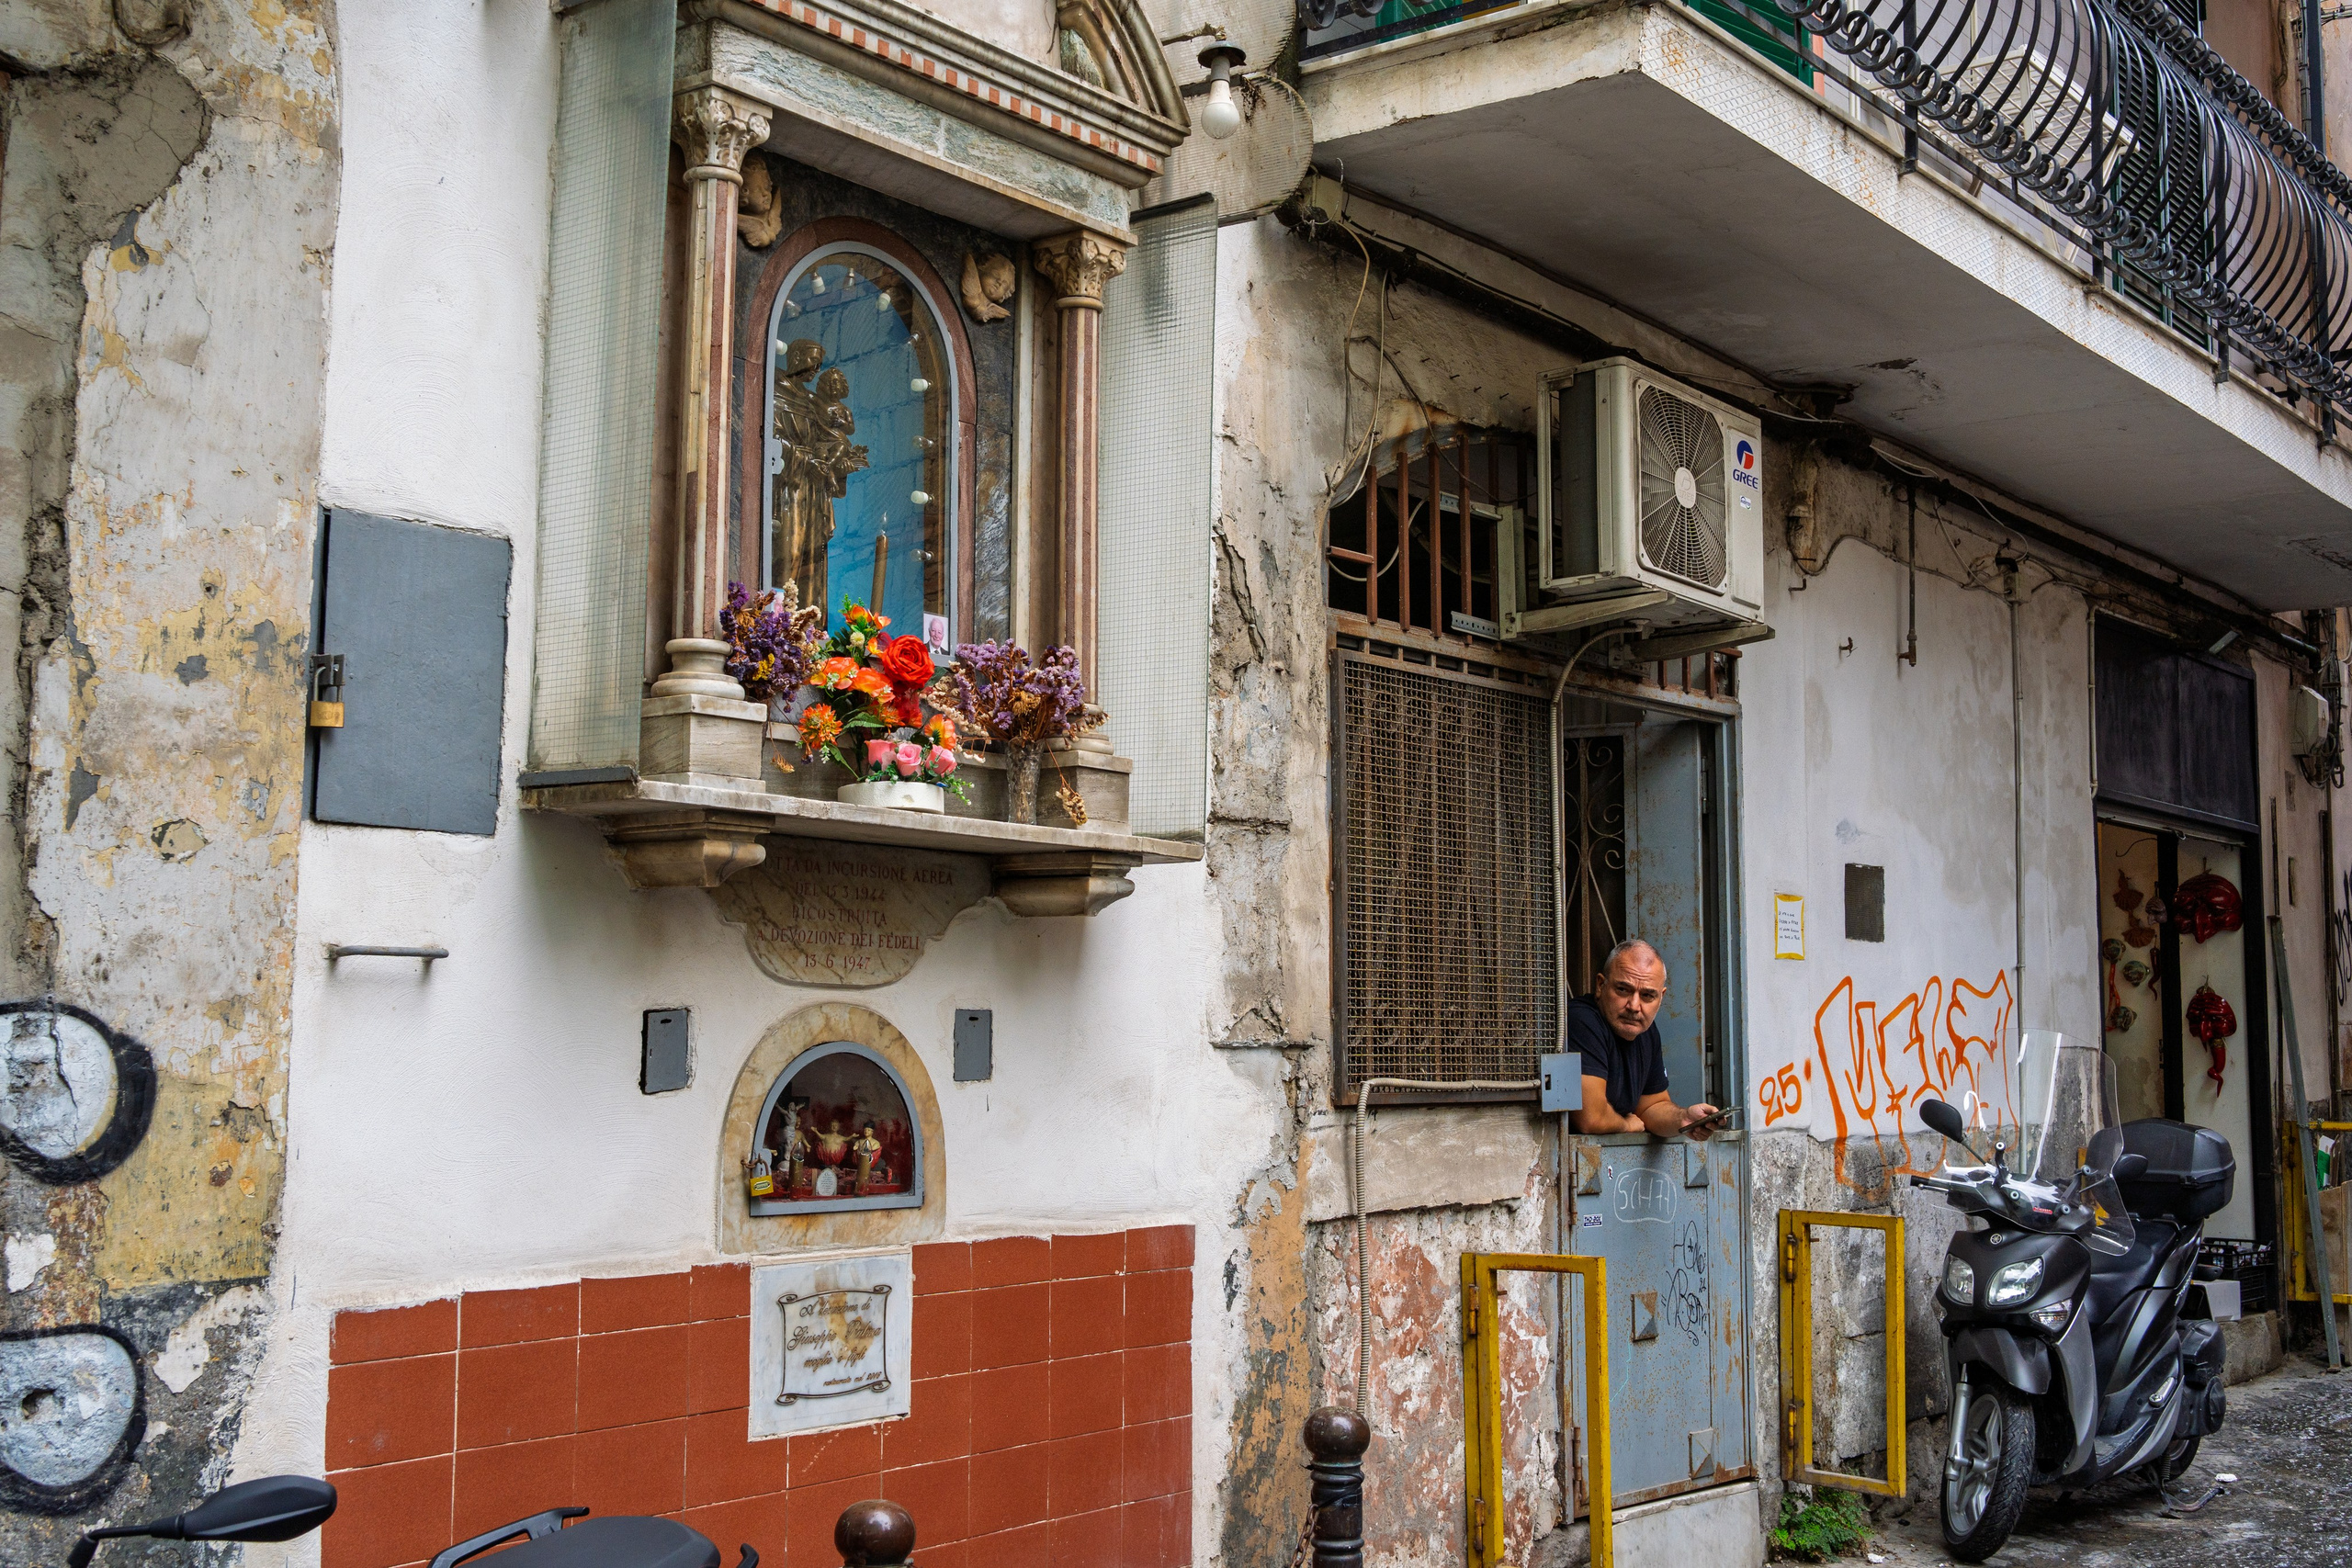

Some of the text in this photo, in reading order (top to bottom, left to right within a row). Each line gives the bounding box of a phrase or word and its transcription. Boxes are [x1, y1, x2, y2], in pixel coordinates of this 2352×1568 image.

[1733, 468, 1758, 490] GREE
[805, 859, 820, 874] DA
[827, 861, 907, 882] INCURSIONE
[912, 869, 954, 886] AEREA
[795, 881, 819, 897] DEL
[855, 886, 887, 902] 1944
[792, 905, 888, 926] RICOSTRUITA
[756, 928, 920, 950] A DEVOZIONE DEI FEDELI
[805, 952, 871, 971] 13 6 1947
[799, 1300, 820, 1317] A
[861, 1296, 873, 1311] di
[786, 1325, 837, 1350] Giuseppe
[803, 1346, 867, 1372] moglie e figli
